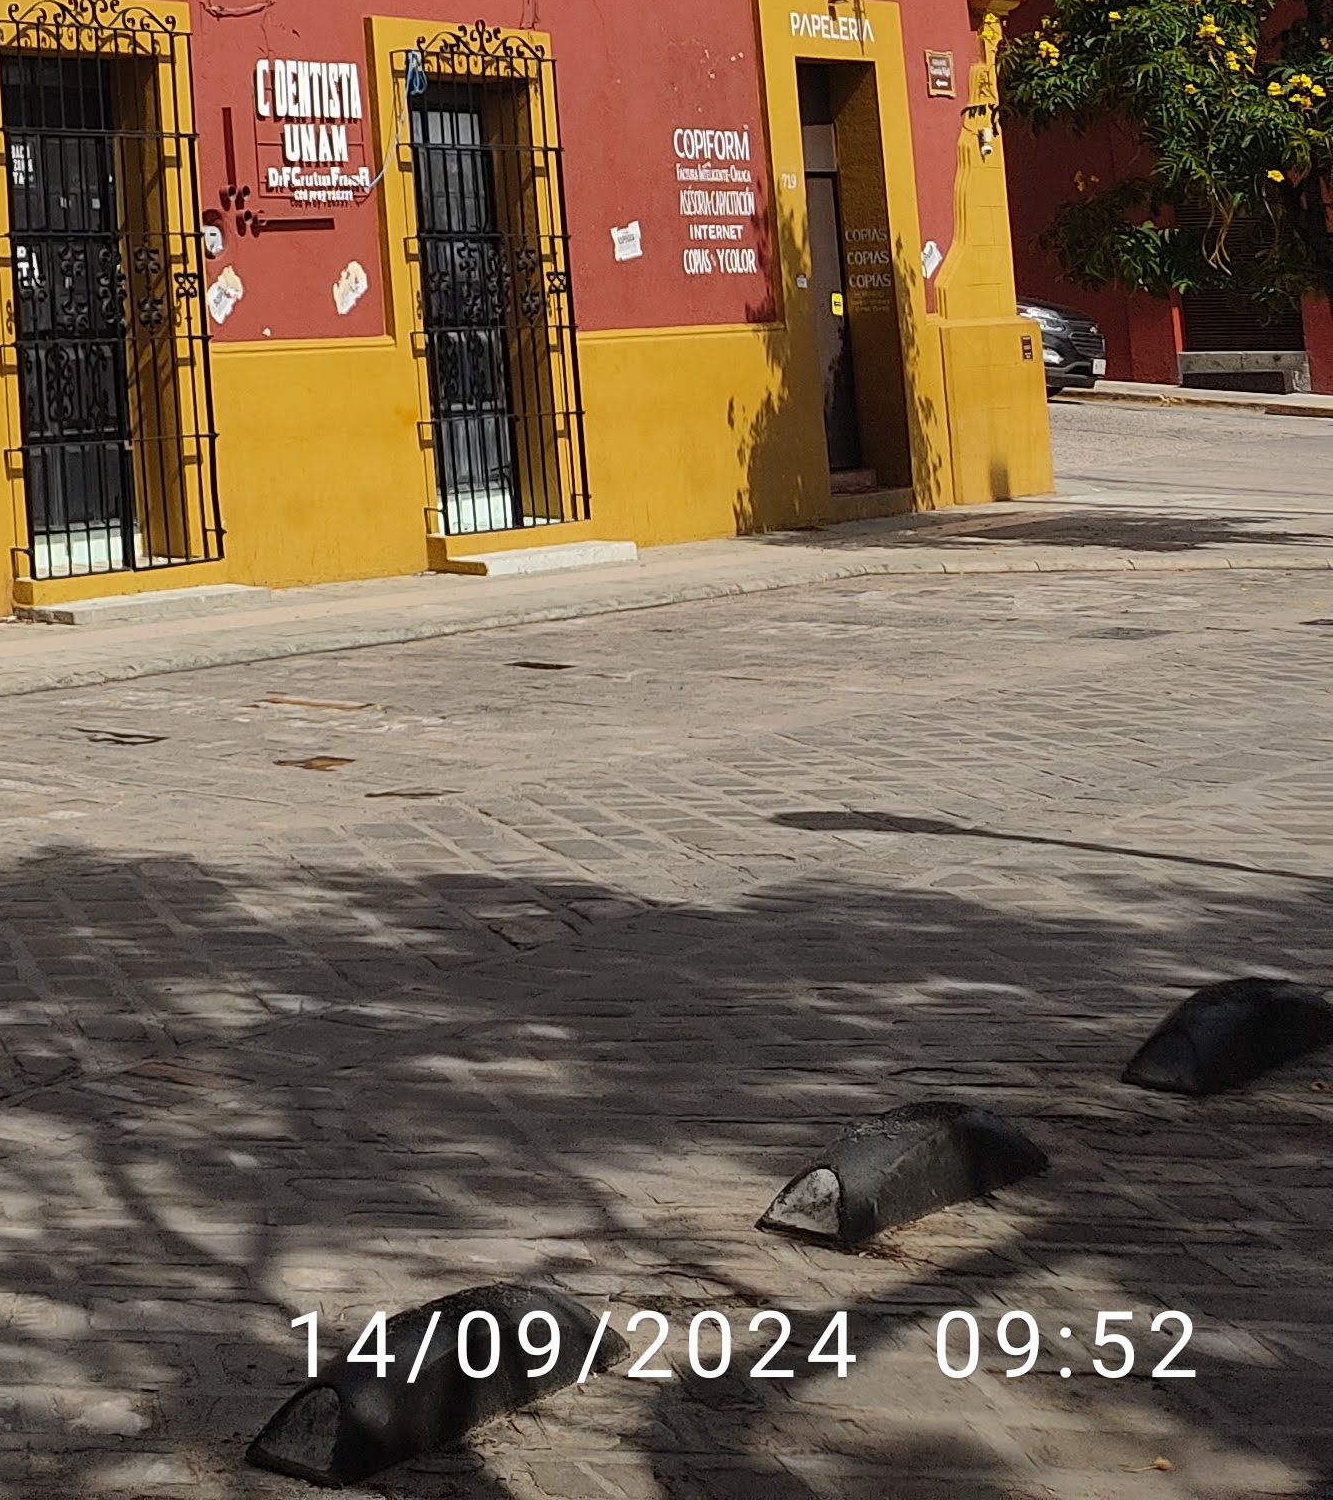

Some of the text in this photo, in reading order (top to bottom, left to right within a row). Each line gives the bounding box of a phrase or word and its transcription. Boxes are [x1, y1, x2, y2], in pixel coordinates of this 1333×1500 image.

[273, 59, 363, 119] DENTISTA
[283, 123, 349, 163] UNAM
[673, 127, 751, 161] COPIFORM
[781, 173, 797, 189] 719
[689, 224, 744, 241] INTERNET
[845, 228, 888, 243] COPIAS
[683, 248, 712, 275] COPIAS
[847, 250, 890, 266] COPIAS
[848, 274, 892, 289] COPIAS
